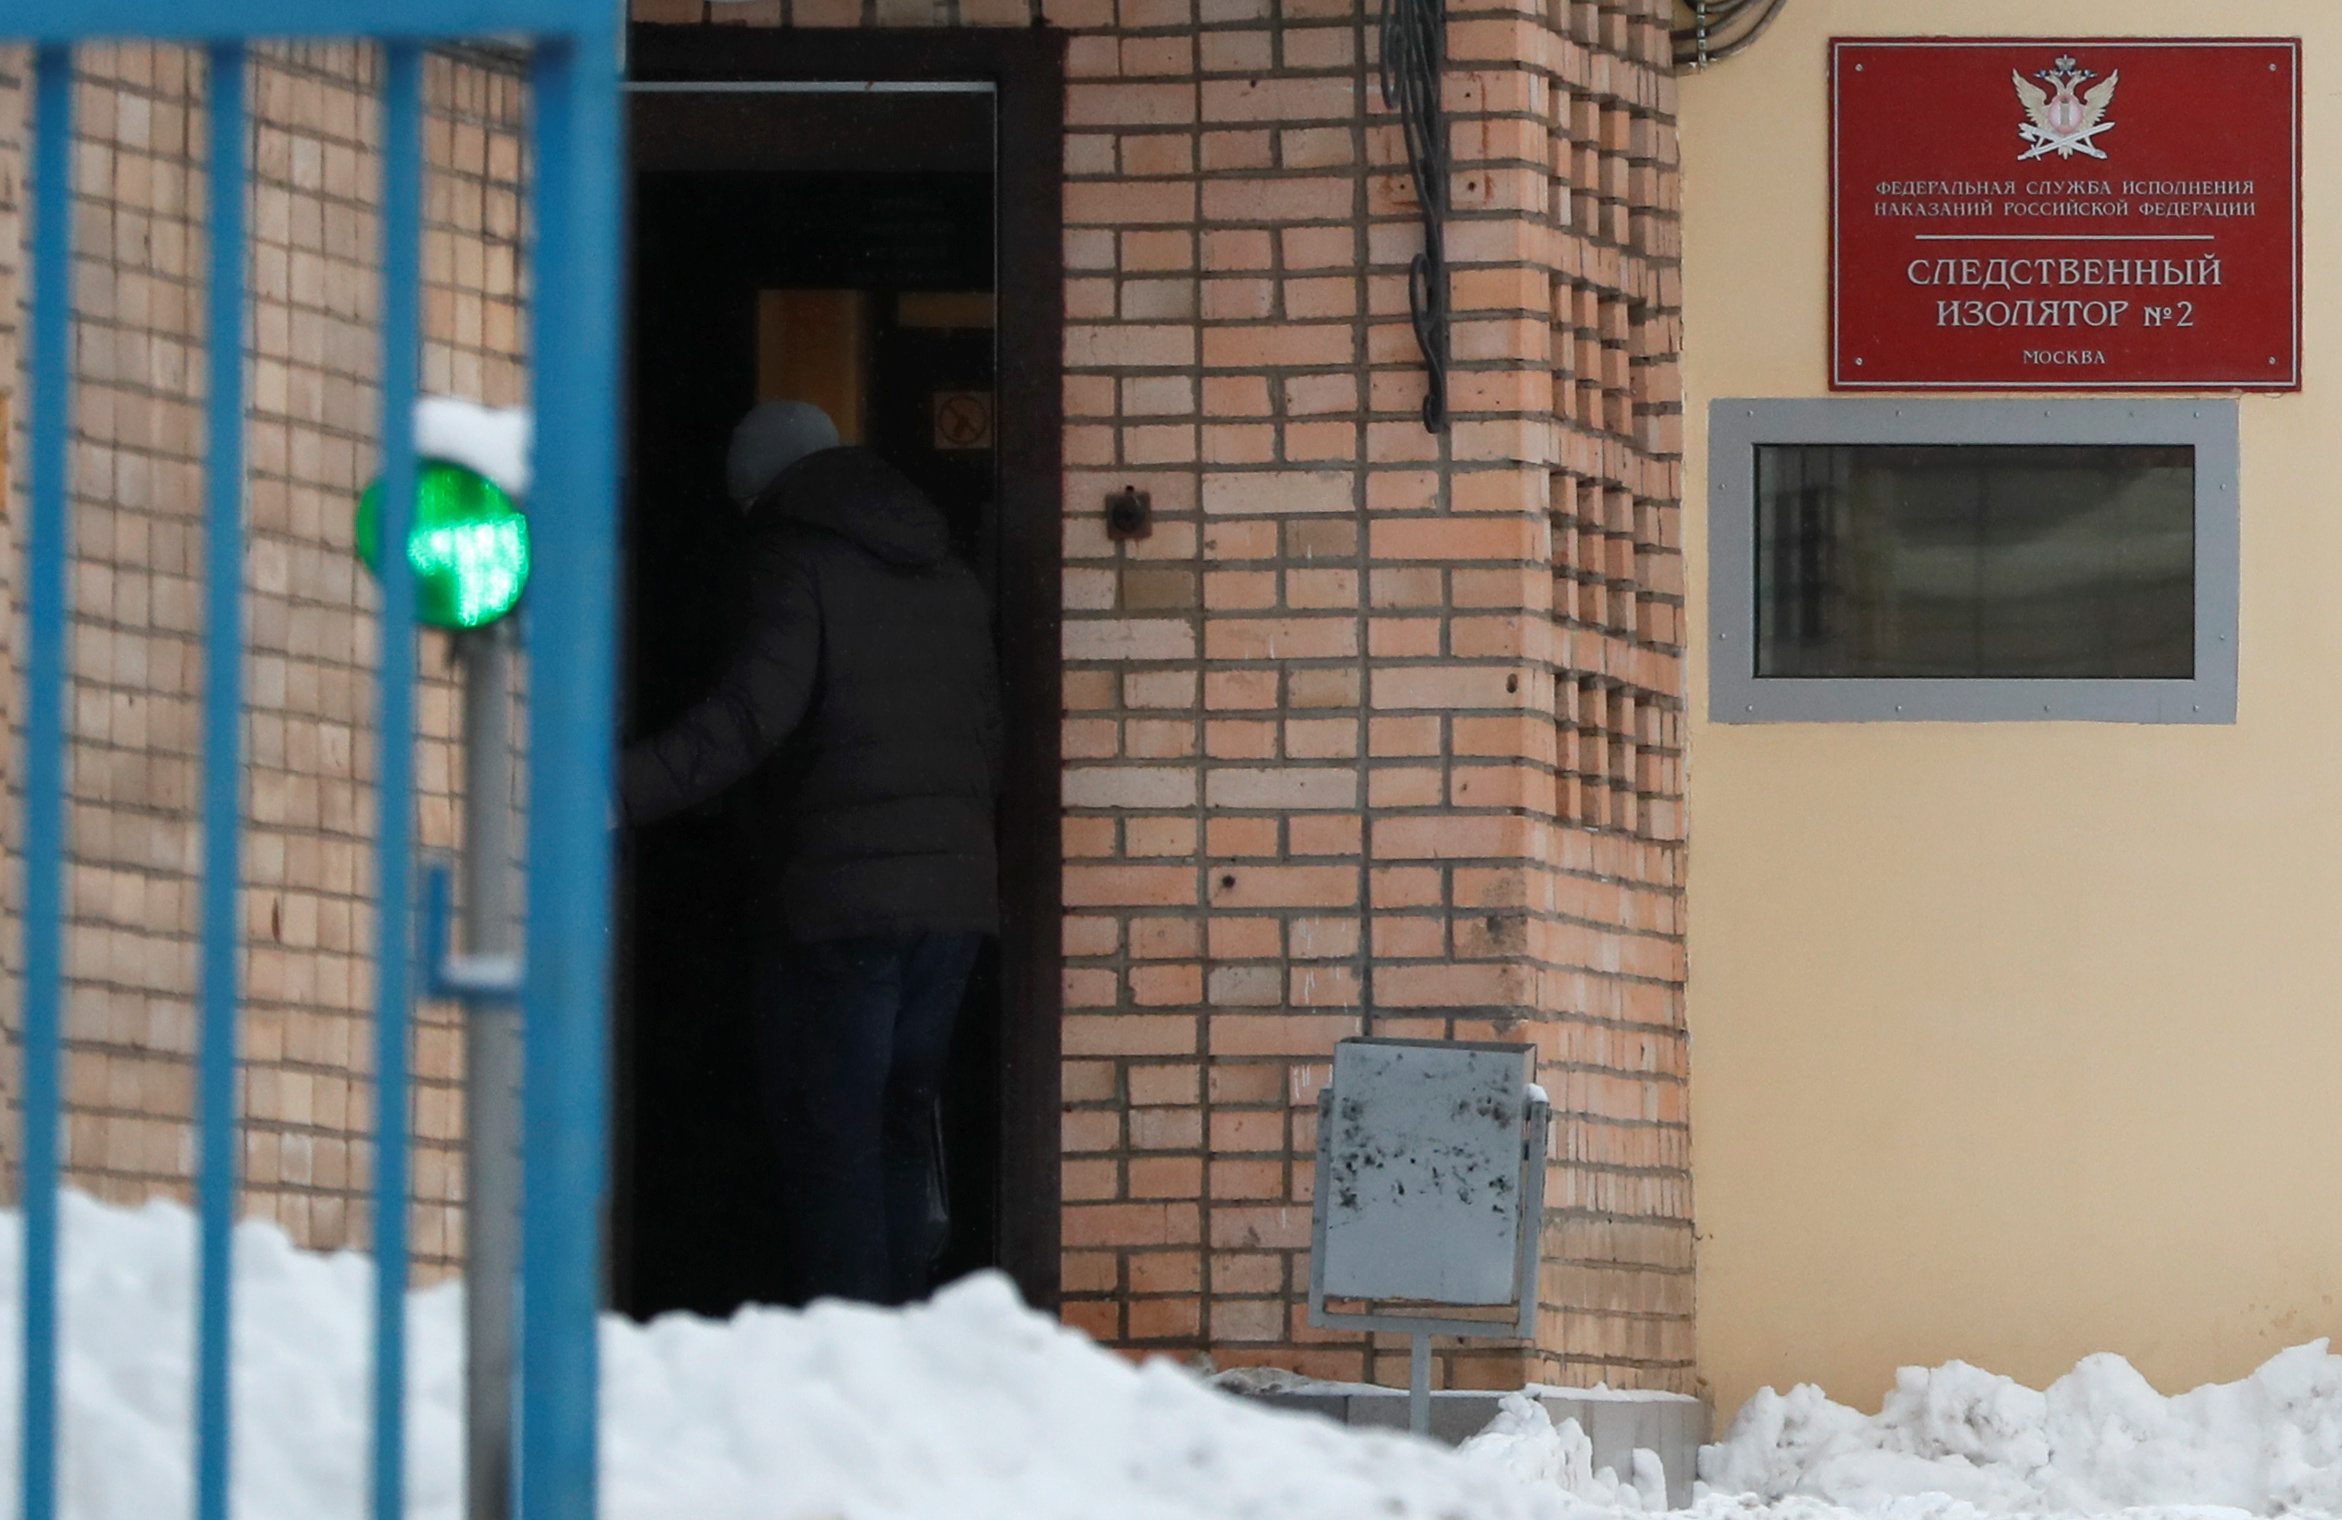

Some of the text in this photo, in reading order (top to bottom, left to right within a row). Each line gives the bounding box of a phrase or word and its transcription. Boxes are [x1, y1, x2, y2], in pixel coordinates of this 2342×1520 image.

[1876, 180, 2254, 197] ФЕДЕРАЛЬНАЯ СЛУЖБА ИСПОЛНЕНИЯ
[1875, 198, 2256, 218] НАКАЗАНИЙ РОССИЙСКОЙ ФЕДЕРАЦИИ
[1907, 253, 2222, 290] СЛЕДСТВЕННЫЙ
[1936, 300, 2129, 327] ИЗОЛЯТОР
[2023, 350, 2106, 365] МОСКВА
